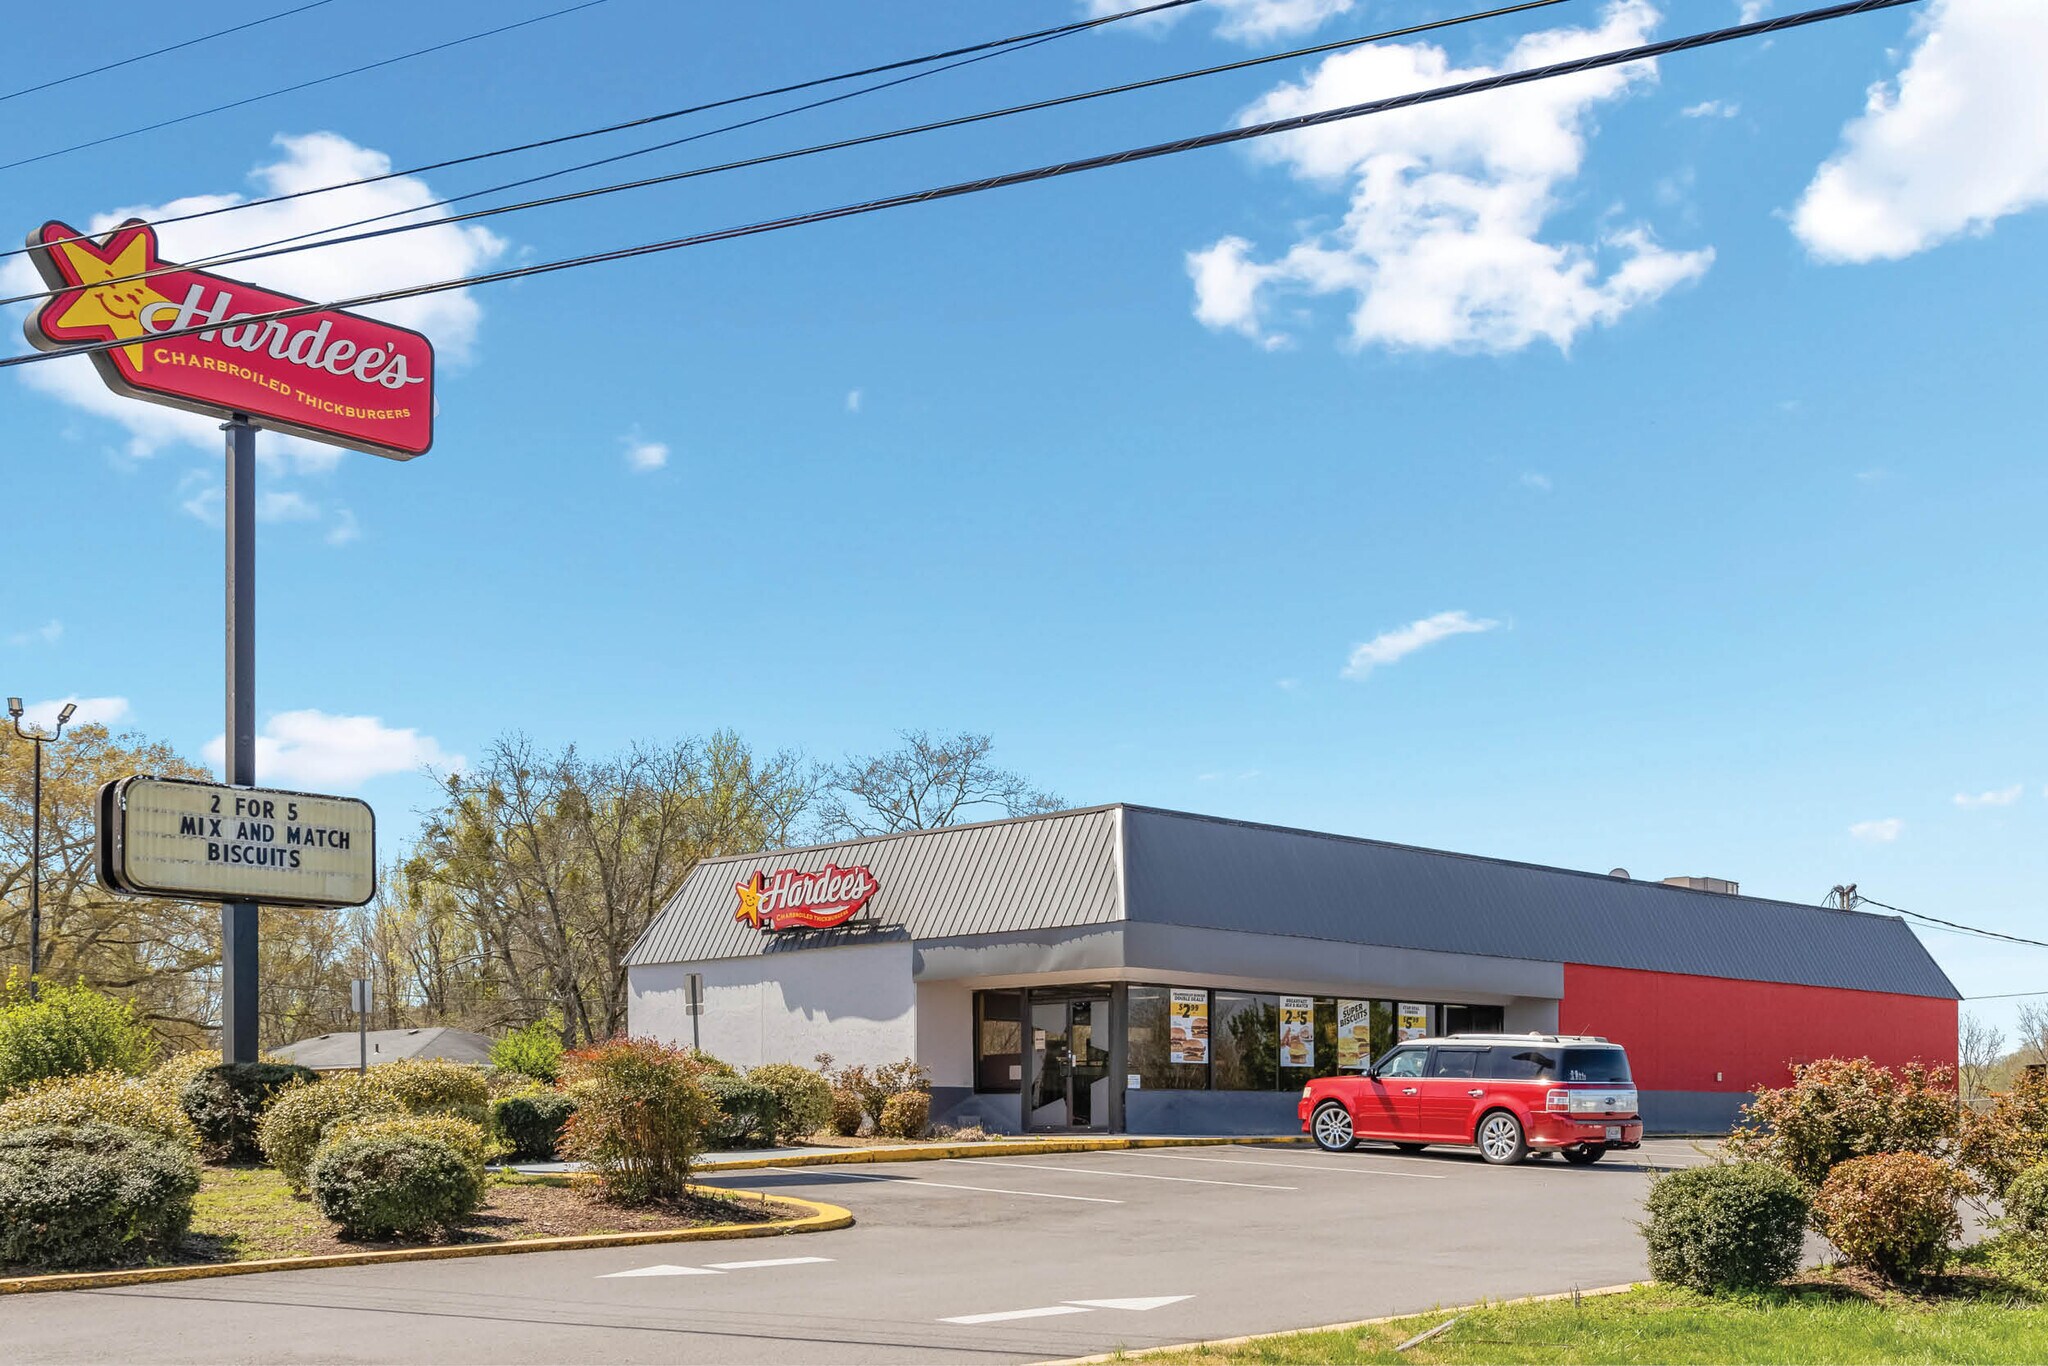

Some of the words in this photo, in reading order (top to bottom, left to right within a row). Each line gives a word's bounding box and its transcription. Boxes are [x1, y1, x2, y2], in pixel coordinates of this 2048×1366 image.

[139, 283, 425, 389] Hardee's
[154, 348, 291, 396] CHARBROILED
[295, 390, 411, 420] THICKBURGERS
[210, 795, 221, 814] 2
[235, 798, 275, 819] FOR
[287, 803, 298, 821] 5
[180, 816, 222, 837] MIX
[236, 822, 275, 843] AND
[287, 826, 351, 850] MATCH
[207, 843, 300, 868] BISCUITS
[757, 867, 873, 914] Hardee's
[776, 912, 813, 921] CHARBROILED
[1284, 1010, 1293, 1025] 2
[1339, 1008, 1368, 1028] BISCUITS
[1342, 1003, 1363, 1019] SUPER
